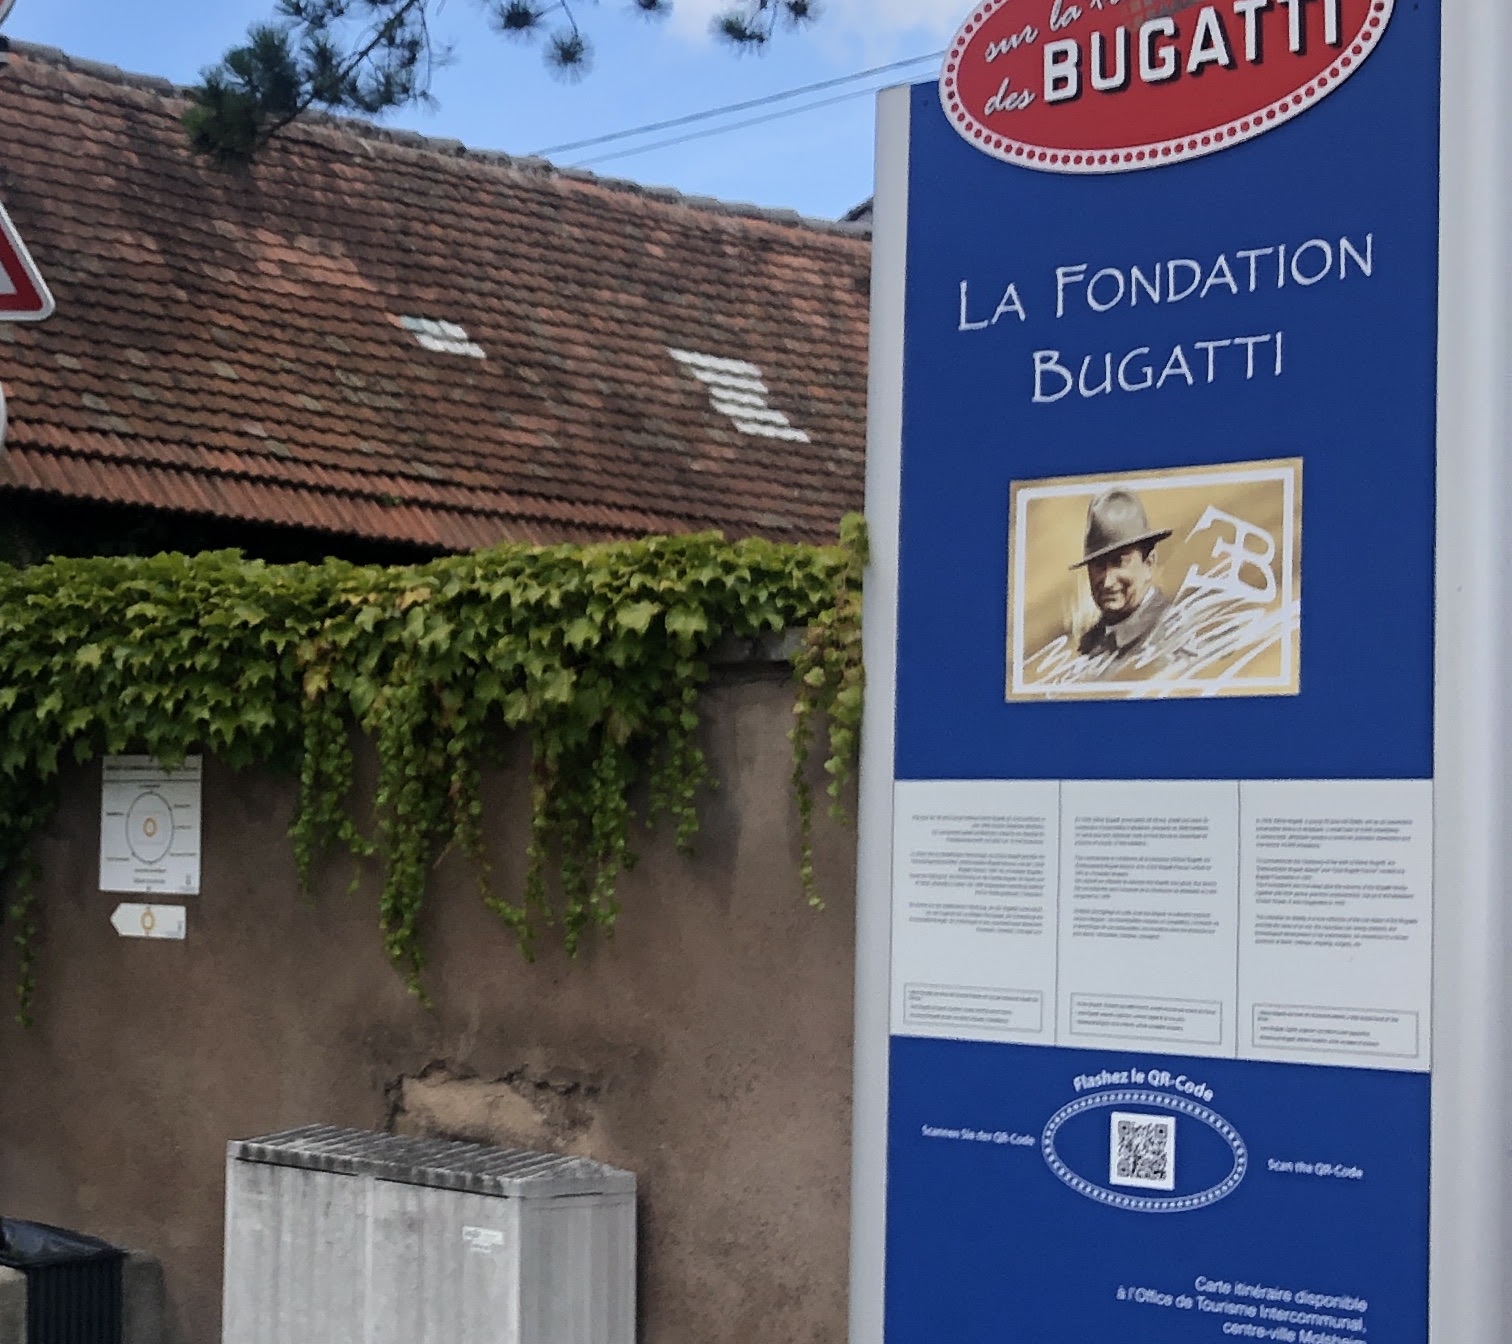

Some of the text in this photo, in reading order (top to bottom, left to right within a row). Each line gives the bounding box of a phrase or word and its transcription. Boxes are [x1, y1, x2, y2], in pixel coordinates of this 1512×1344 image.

[984, 25, 1038, 63] sur
[983, 77, 1036, 116] des
[958, 232, 1374, 332] LA FONDATION
[1031, 331, 1284, 404] BUGATTI
[1072, 1067, 1214, 1103] Flashez le QR-Code
[1314, 1162, 1364, 1179] QR-Code
[1116, 1284, 1127, 1300] à
[1175, 1294, 1194, 1309] de
[1195, 1295, 1257, 1318] Tourisme
[1194, 1275, 1232, 1295] Carte
[1294, 1289, 1368, 1313] disponible
